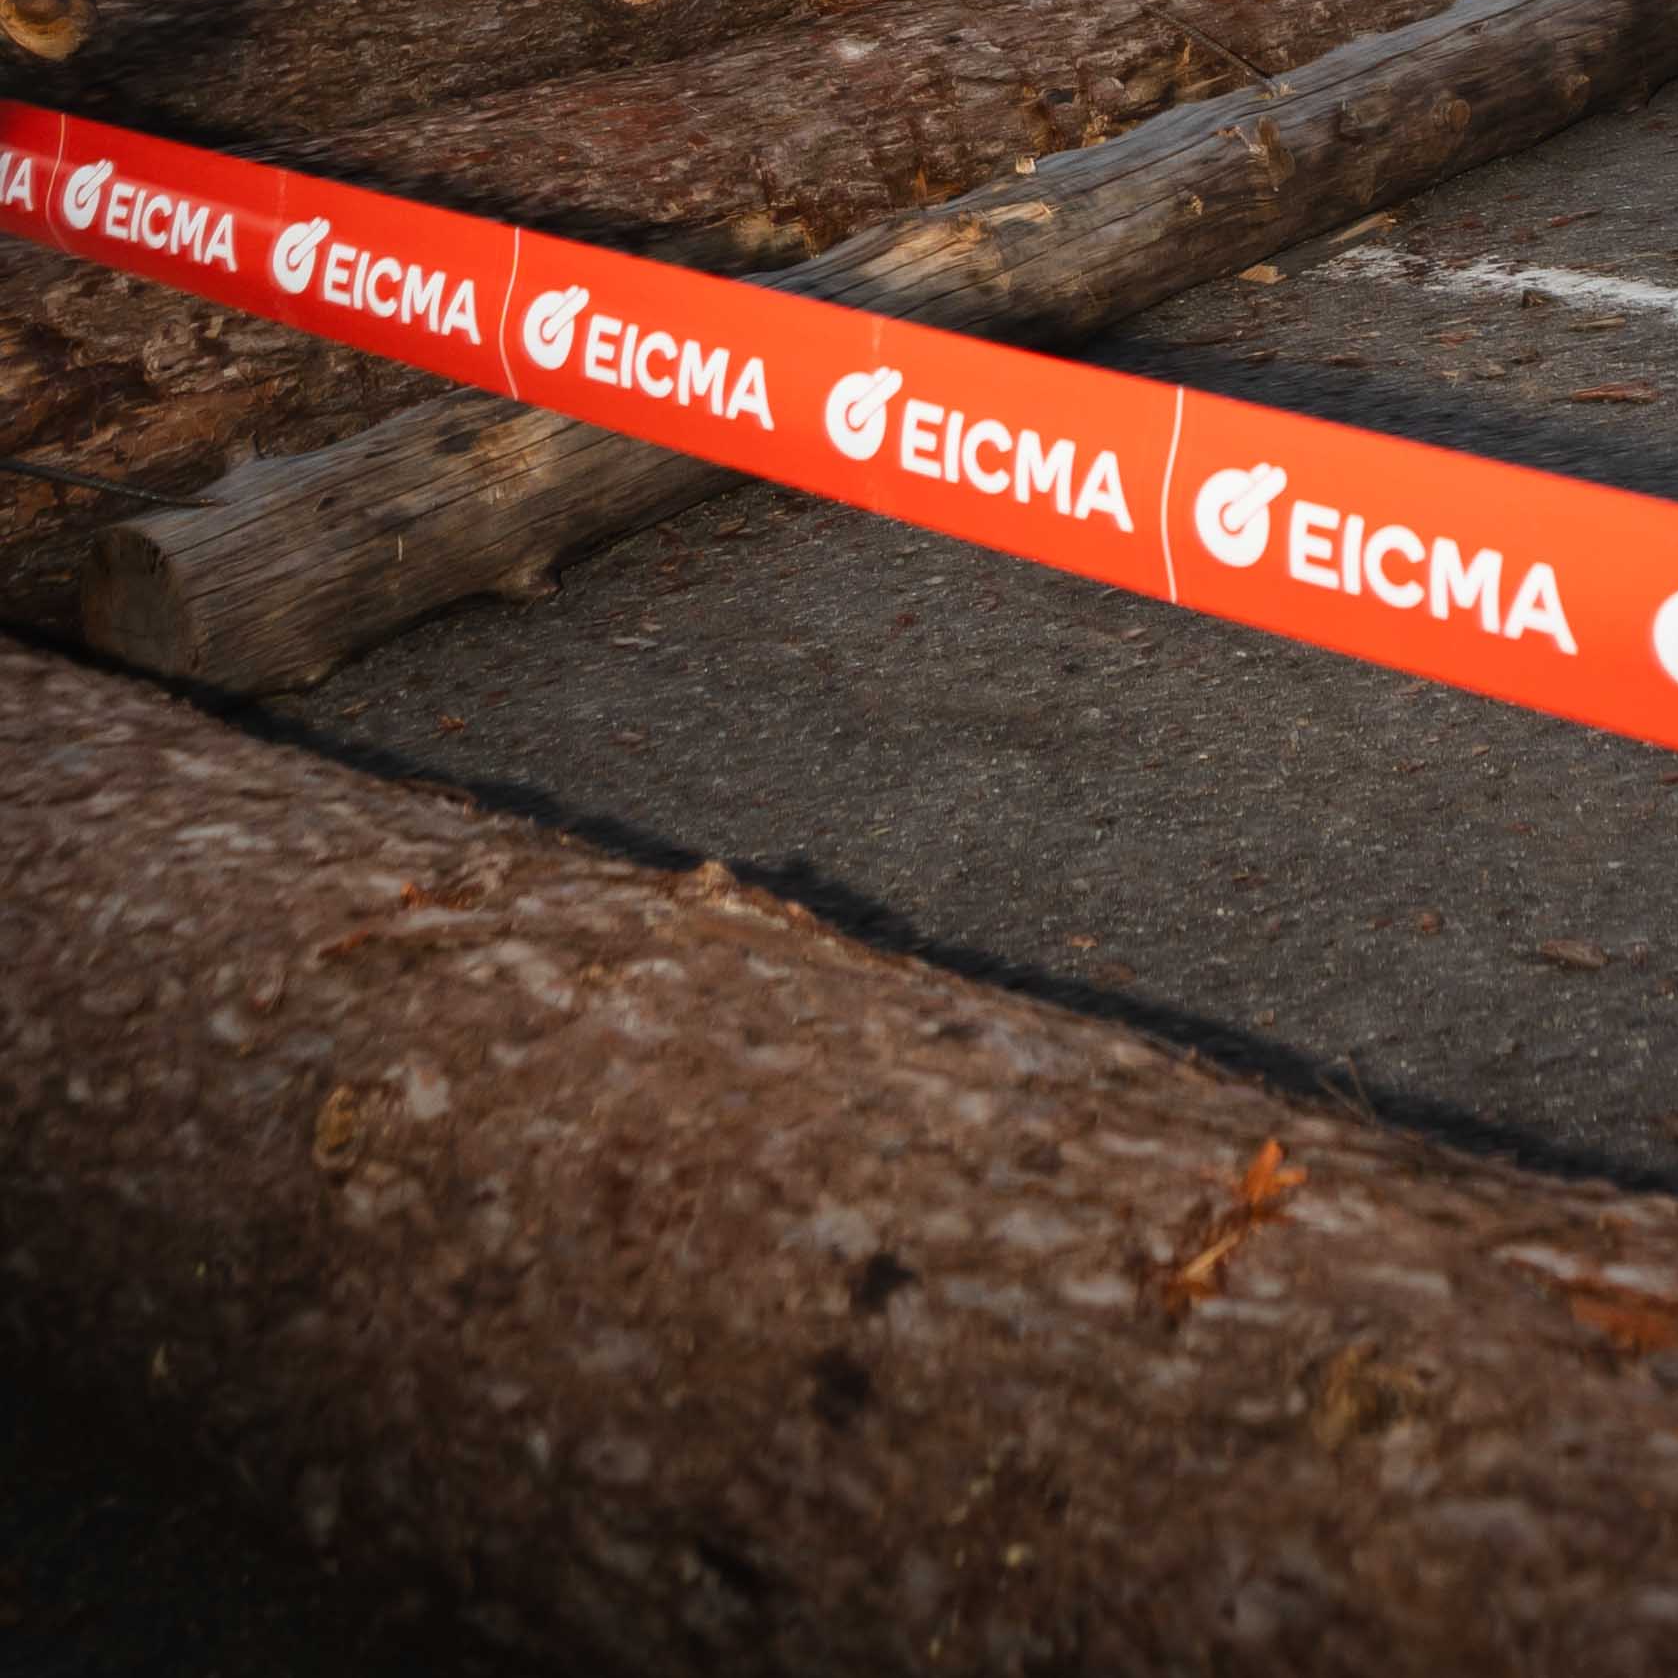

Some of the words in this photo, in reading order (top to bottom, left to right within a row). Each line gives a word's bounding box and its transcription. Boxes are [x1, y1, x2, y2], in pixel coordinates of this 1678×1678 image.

[105, 182, 239, 272] EICMA
[322, 242, 481, 345] EICMA
[583, 313, 775, 431] EICMA
[899, 399, 1135, 533] EICMA
[1287, 499, 1578, 655] EICMA
